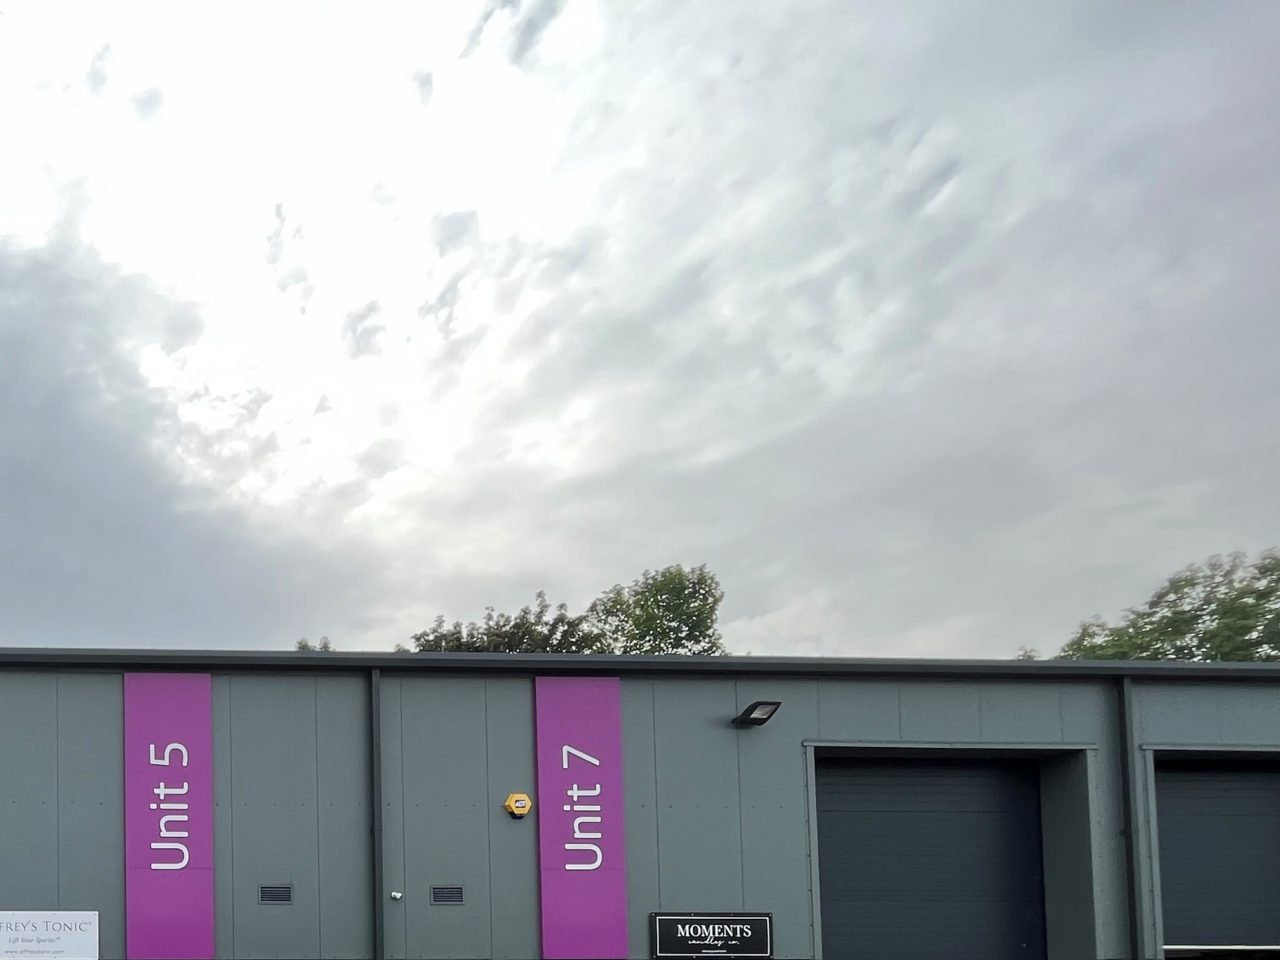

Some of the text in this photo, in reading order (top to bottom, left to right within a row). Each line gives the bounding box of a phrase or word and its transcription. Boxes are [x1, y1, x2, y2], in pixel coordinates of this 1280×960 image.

[149, 742, 190, 870] Unit 5
[562, 744, 603, 870] Unit 7
[677, 924, 752, 938] MOMENTS
